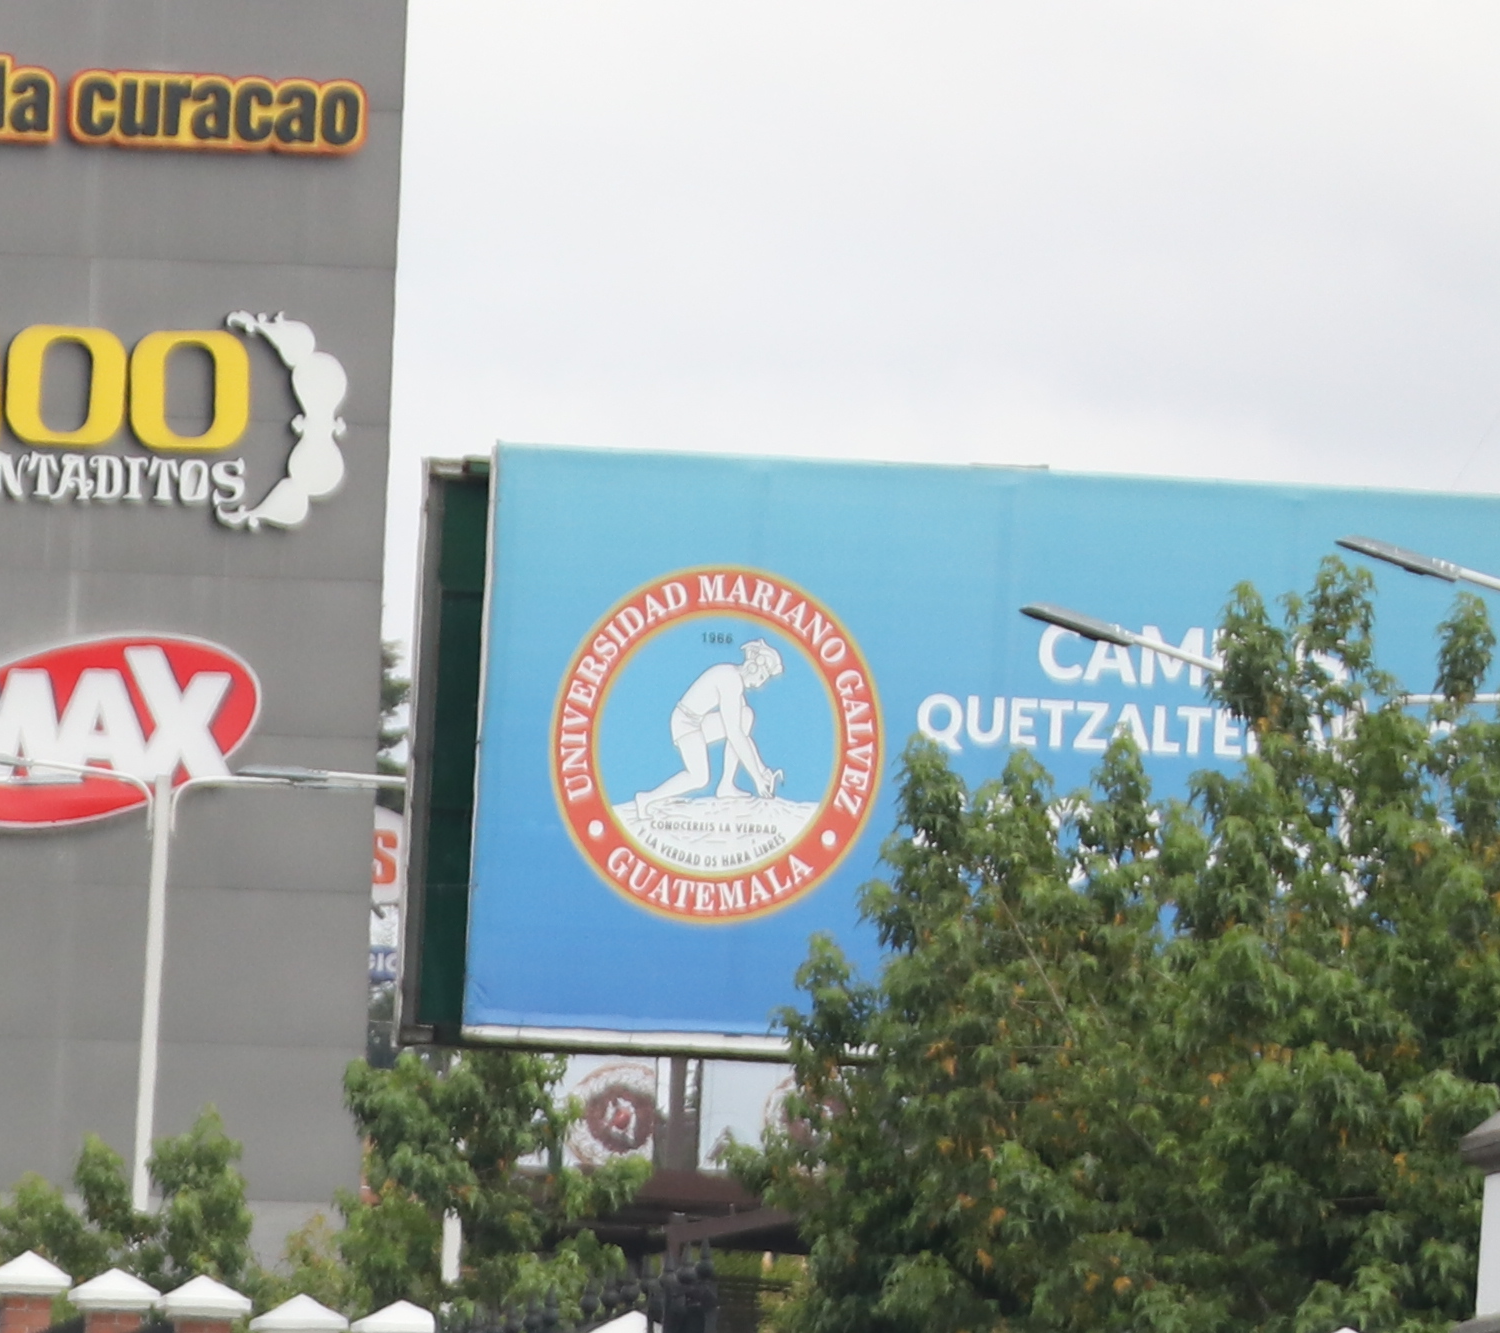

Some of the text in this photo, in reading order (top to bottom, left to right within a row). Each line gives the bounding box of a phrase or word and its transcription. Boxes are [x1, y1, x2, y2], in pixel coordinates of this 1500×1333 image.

[72, 73, 364, 150] curacao
[702, 631, 733, 644] 1966
[1039, 622, 1350, 690] CAMS
[560, 573, 875, 816] UNIVERSIDAD MARIANO GALVEZ
[660, 844, 700, 866] VERDAD
[719, 823, 731, 832] LA
[735, 823, 778, 835] VERDAD
[606, 847, 814, 912] GUATEMALA
